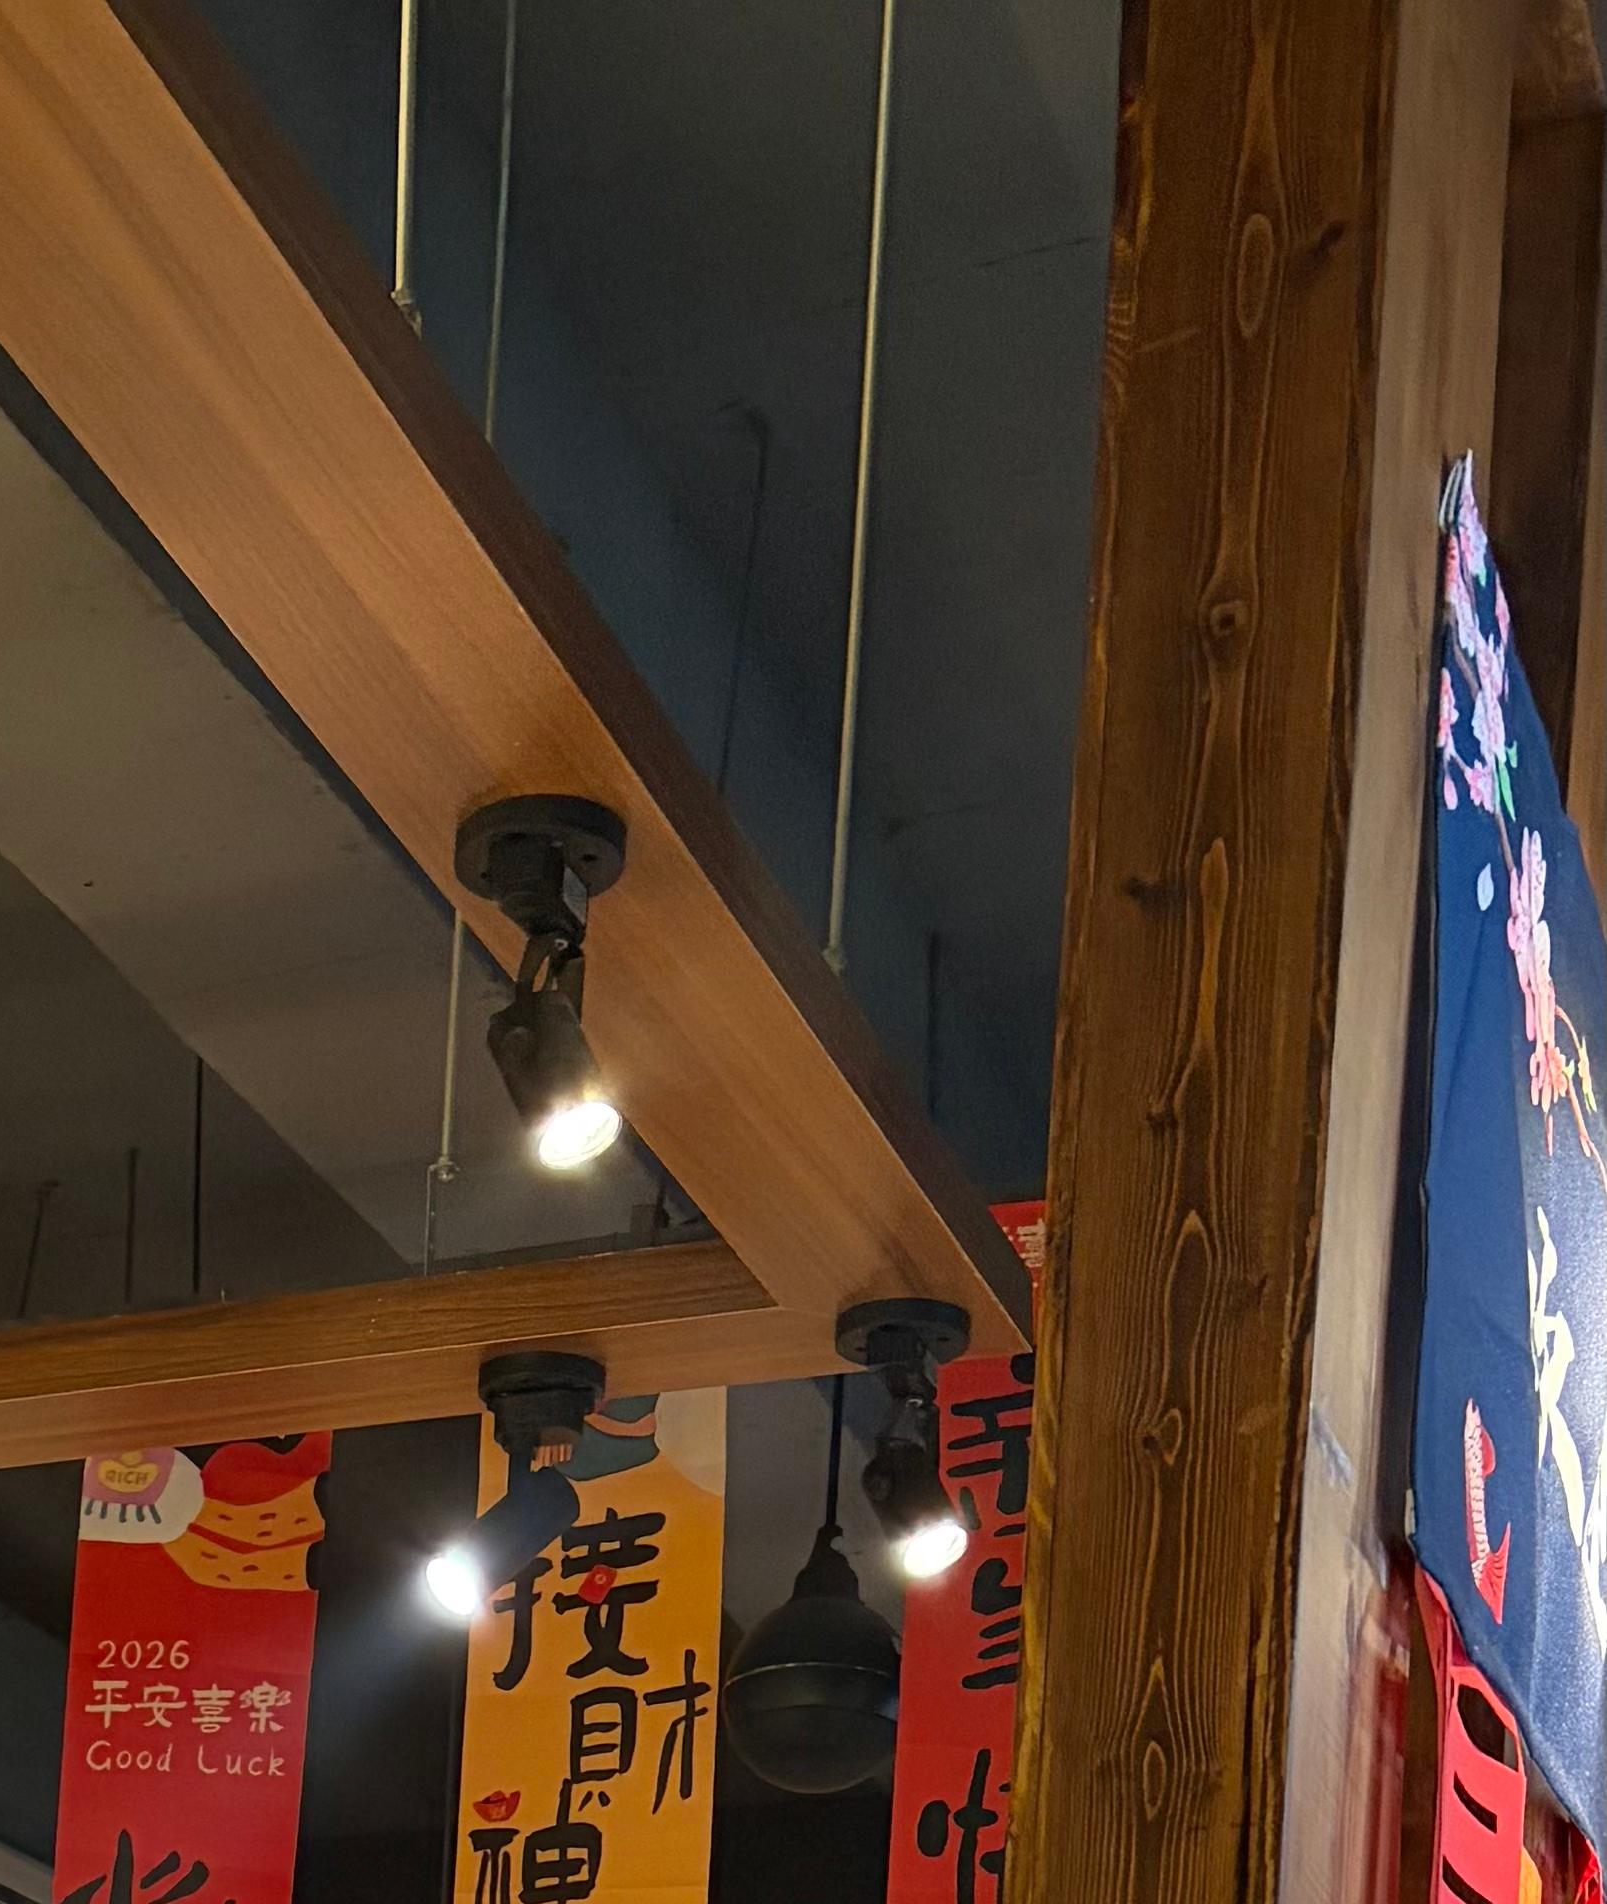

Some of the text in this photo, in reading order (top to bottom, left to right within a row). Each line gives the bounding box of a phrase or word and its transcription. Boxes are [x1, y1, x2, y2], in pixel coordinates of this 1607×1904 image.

[104, 1467, 150, 1489] RICH
[97, 1639, 191, 1671] 2026
[84, 1681, 292, 1735] 平安喜樂
[85, 1740, 286, 1779] Good Luck
